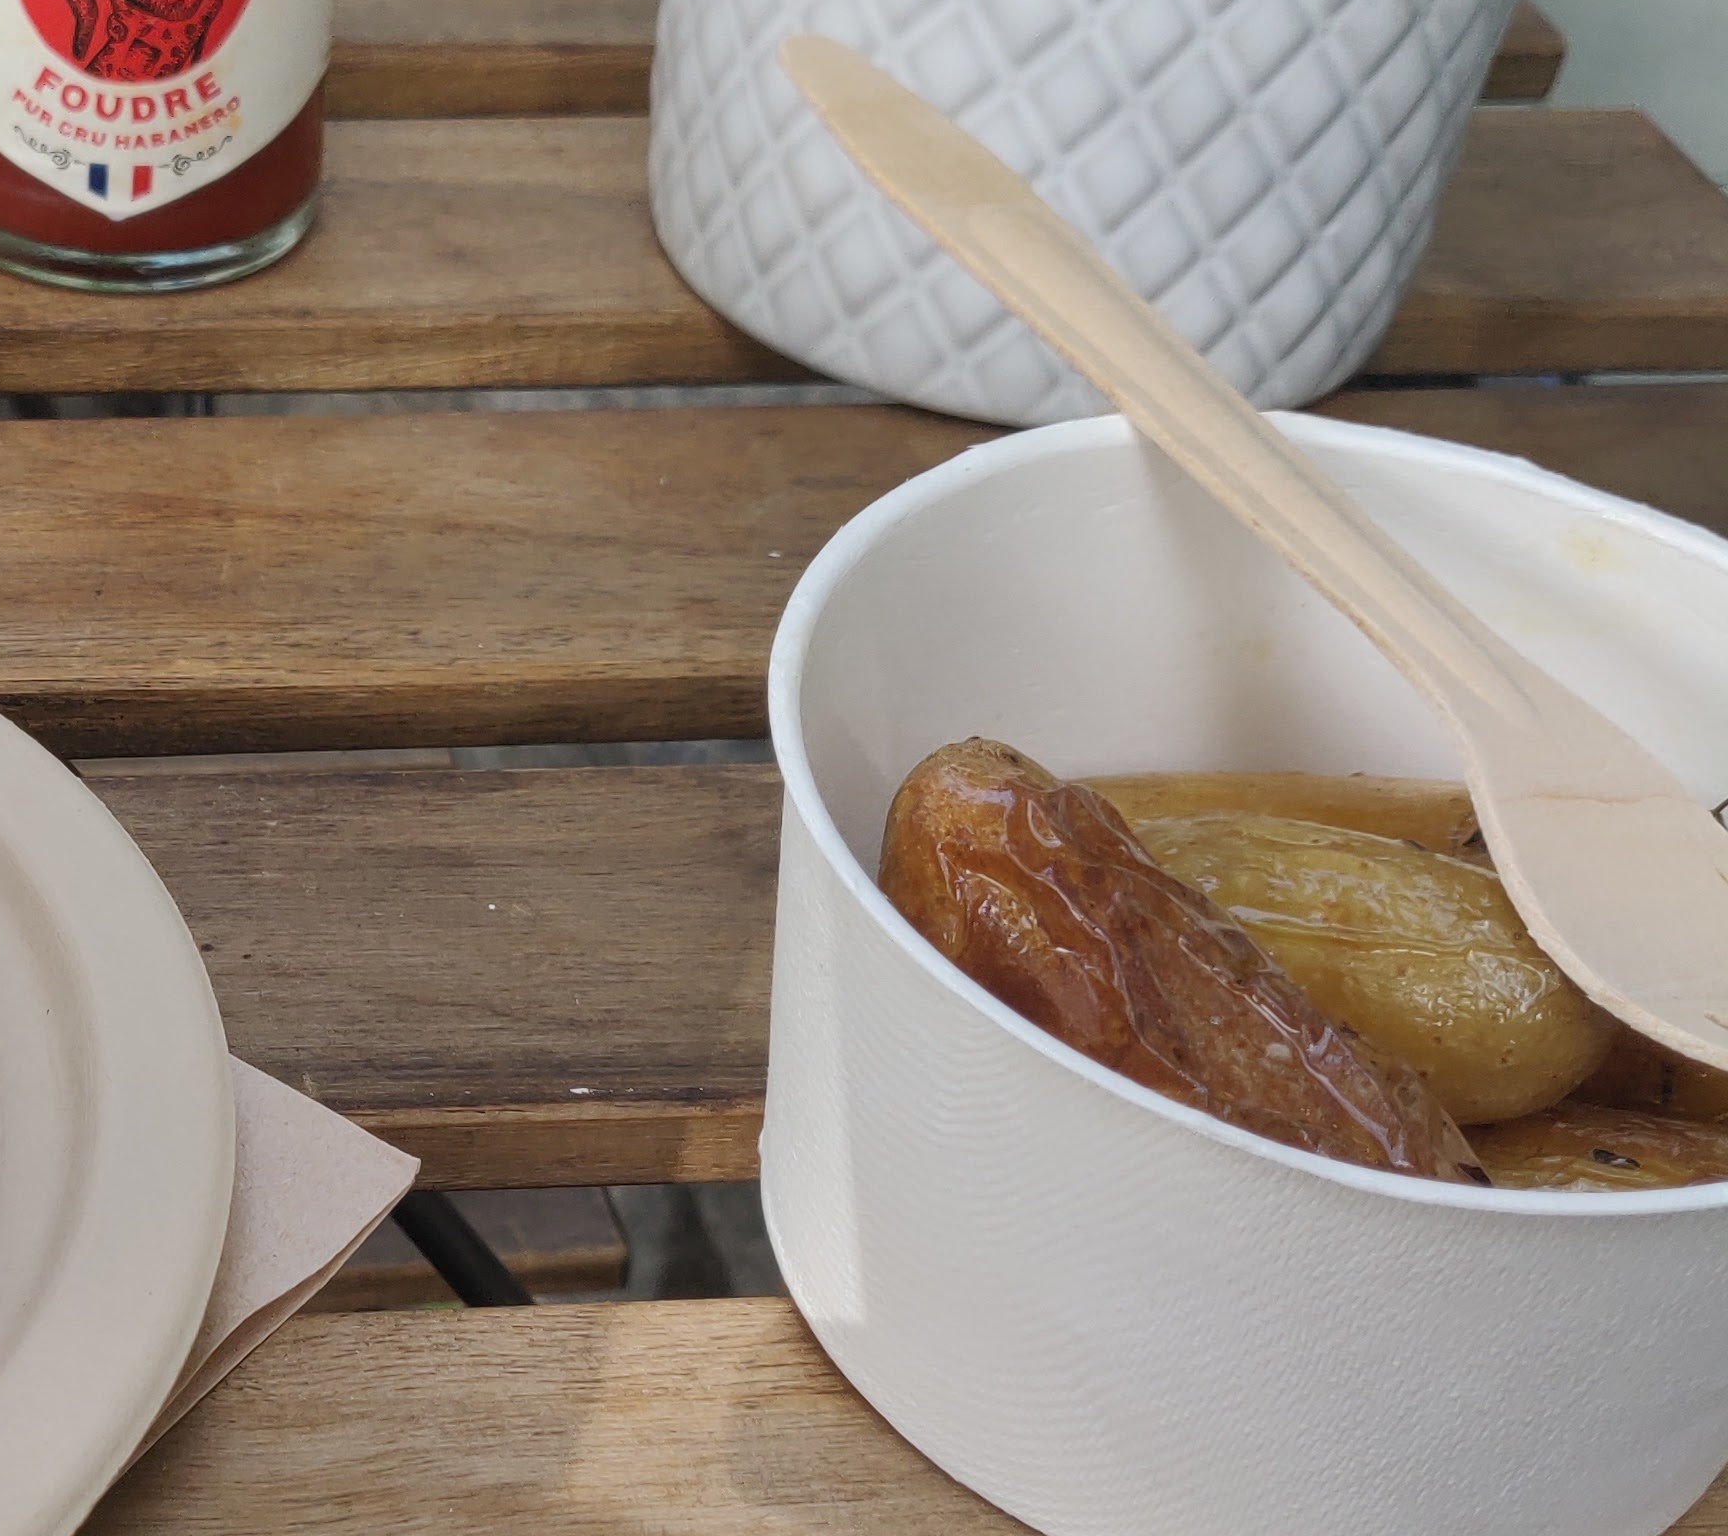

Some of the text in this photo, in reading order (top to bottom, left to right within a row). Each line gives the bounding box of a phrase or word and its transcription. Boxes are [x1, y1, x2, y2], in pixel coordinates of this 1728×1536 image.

[11, 88, 241, 152] PUR CRU HABANERO
[33, 66, 223, 126] FOUDRE
